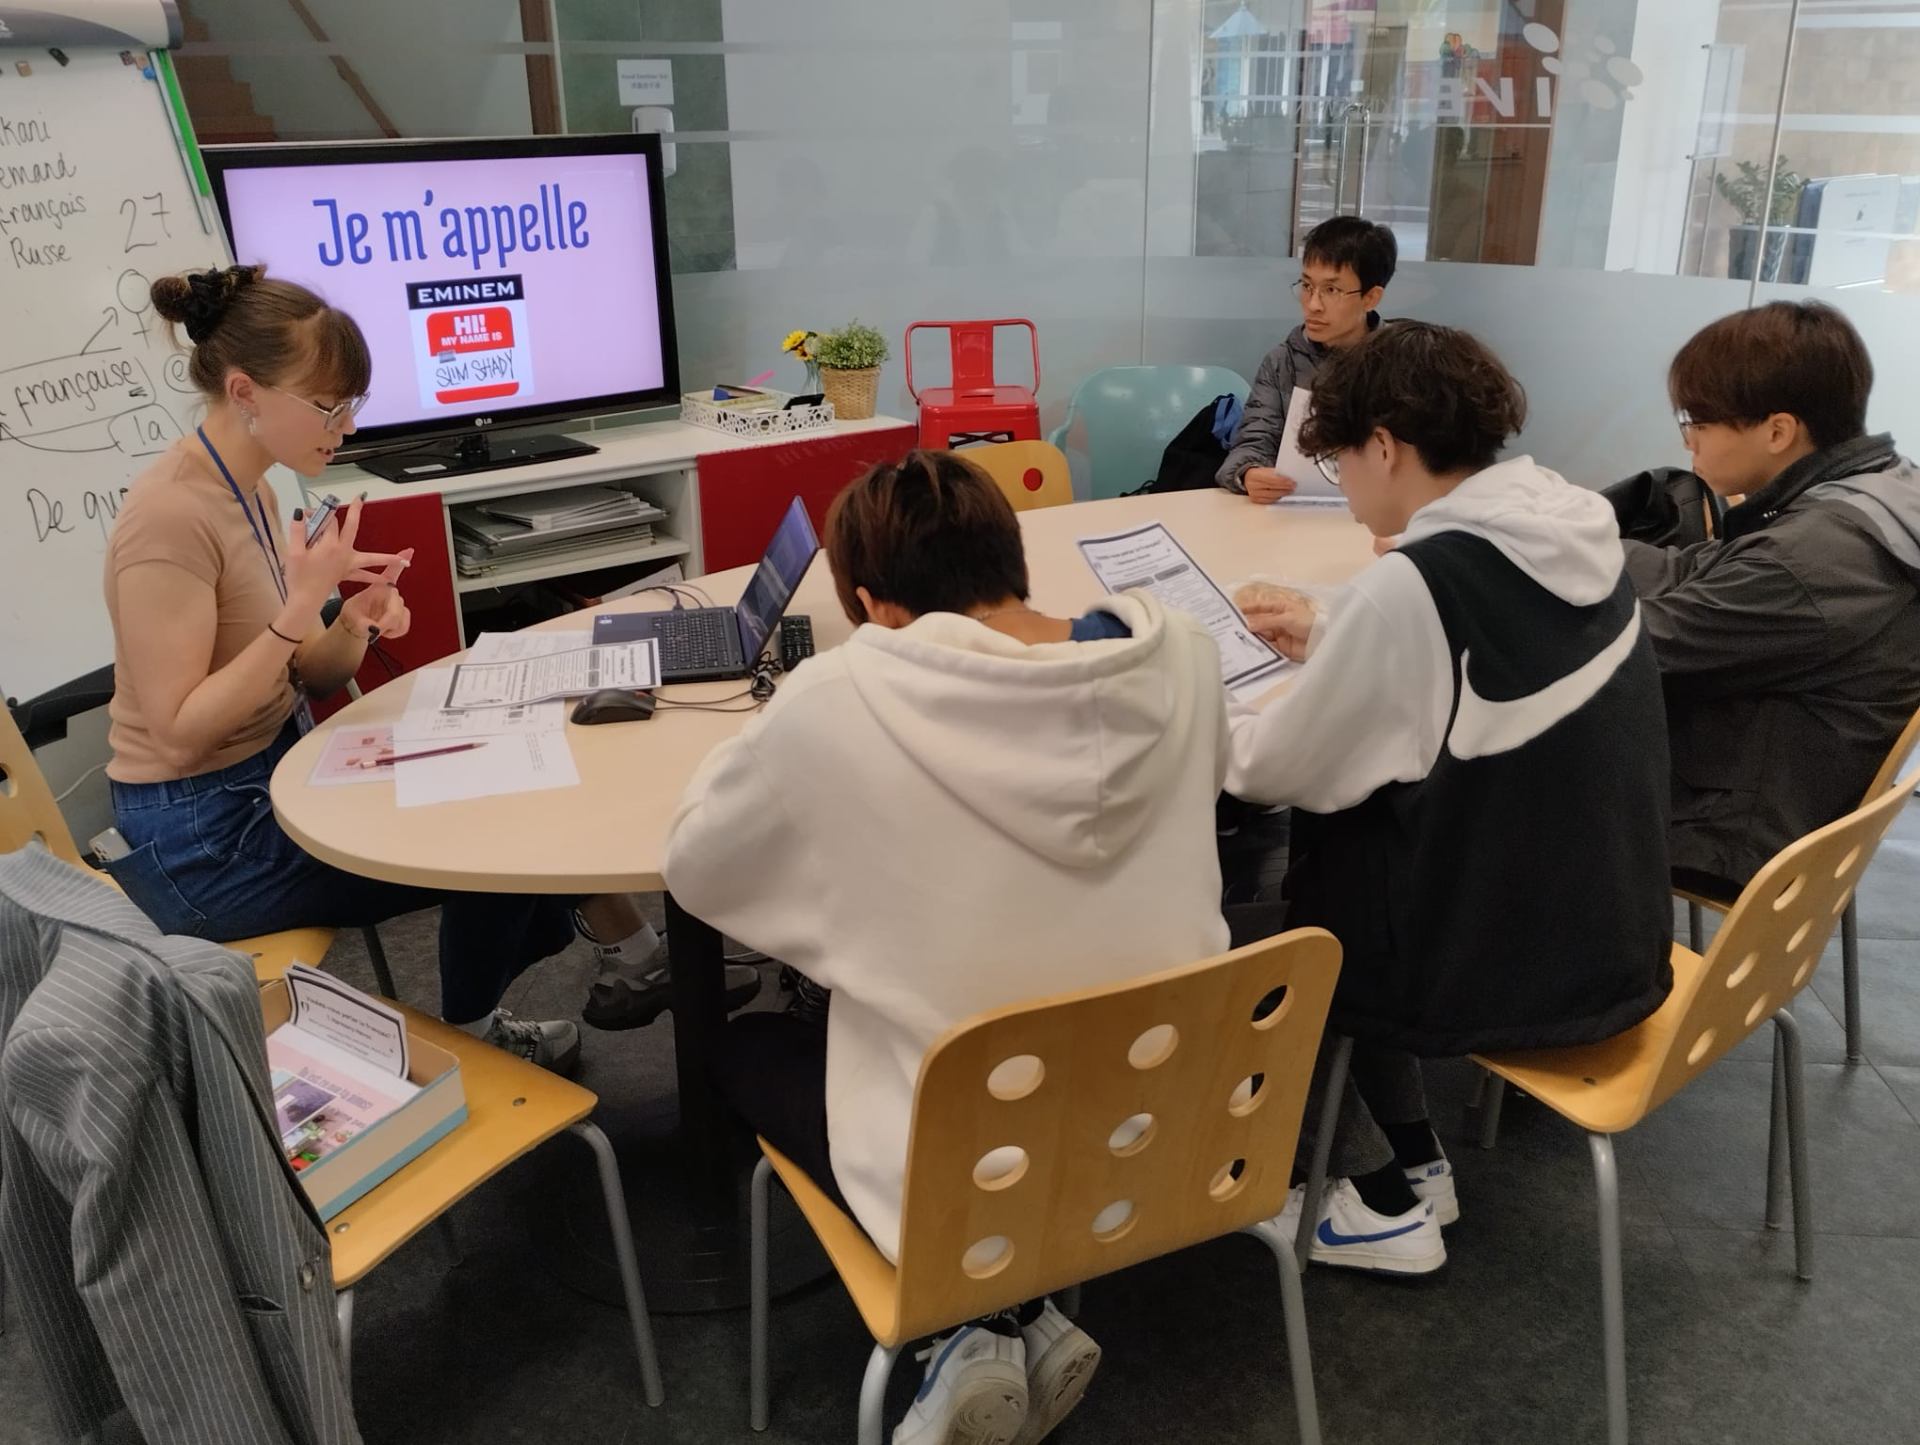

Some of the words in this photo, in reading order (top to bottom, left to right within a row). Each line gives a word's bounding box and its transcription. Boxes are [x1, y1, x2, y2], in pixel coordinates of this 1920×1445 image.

[119, 192, 172, 253] 27
[312, 199, 372, 267] Je
[382, 183, 590, 270] m'appelle
[10, 236, 72, 269] Russe
[417, 280, 516, 303] EMINEM
[440, 336, 458, 347] MY
[460, 333, 490, 345] NAME
[492, 331, 504, 342] IS
[453, 314, 487, 336] HI!
[436, 362, 469, 388] SLIM
[470, 349, 515, 382] SHADY
[14, 360, 139, 427] française
[26, 488, 76, 543] De
